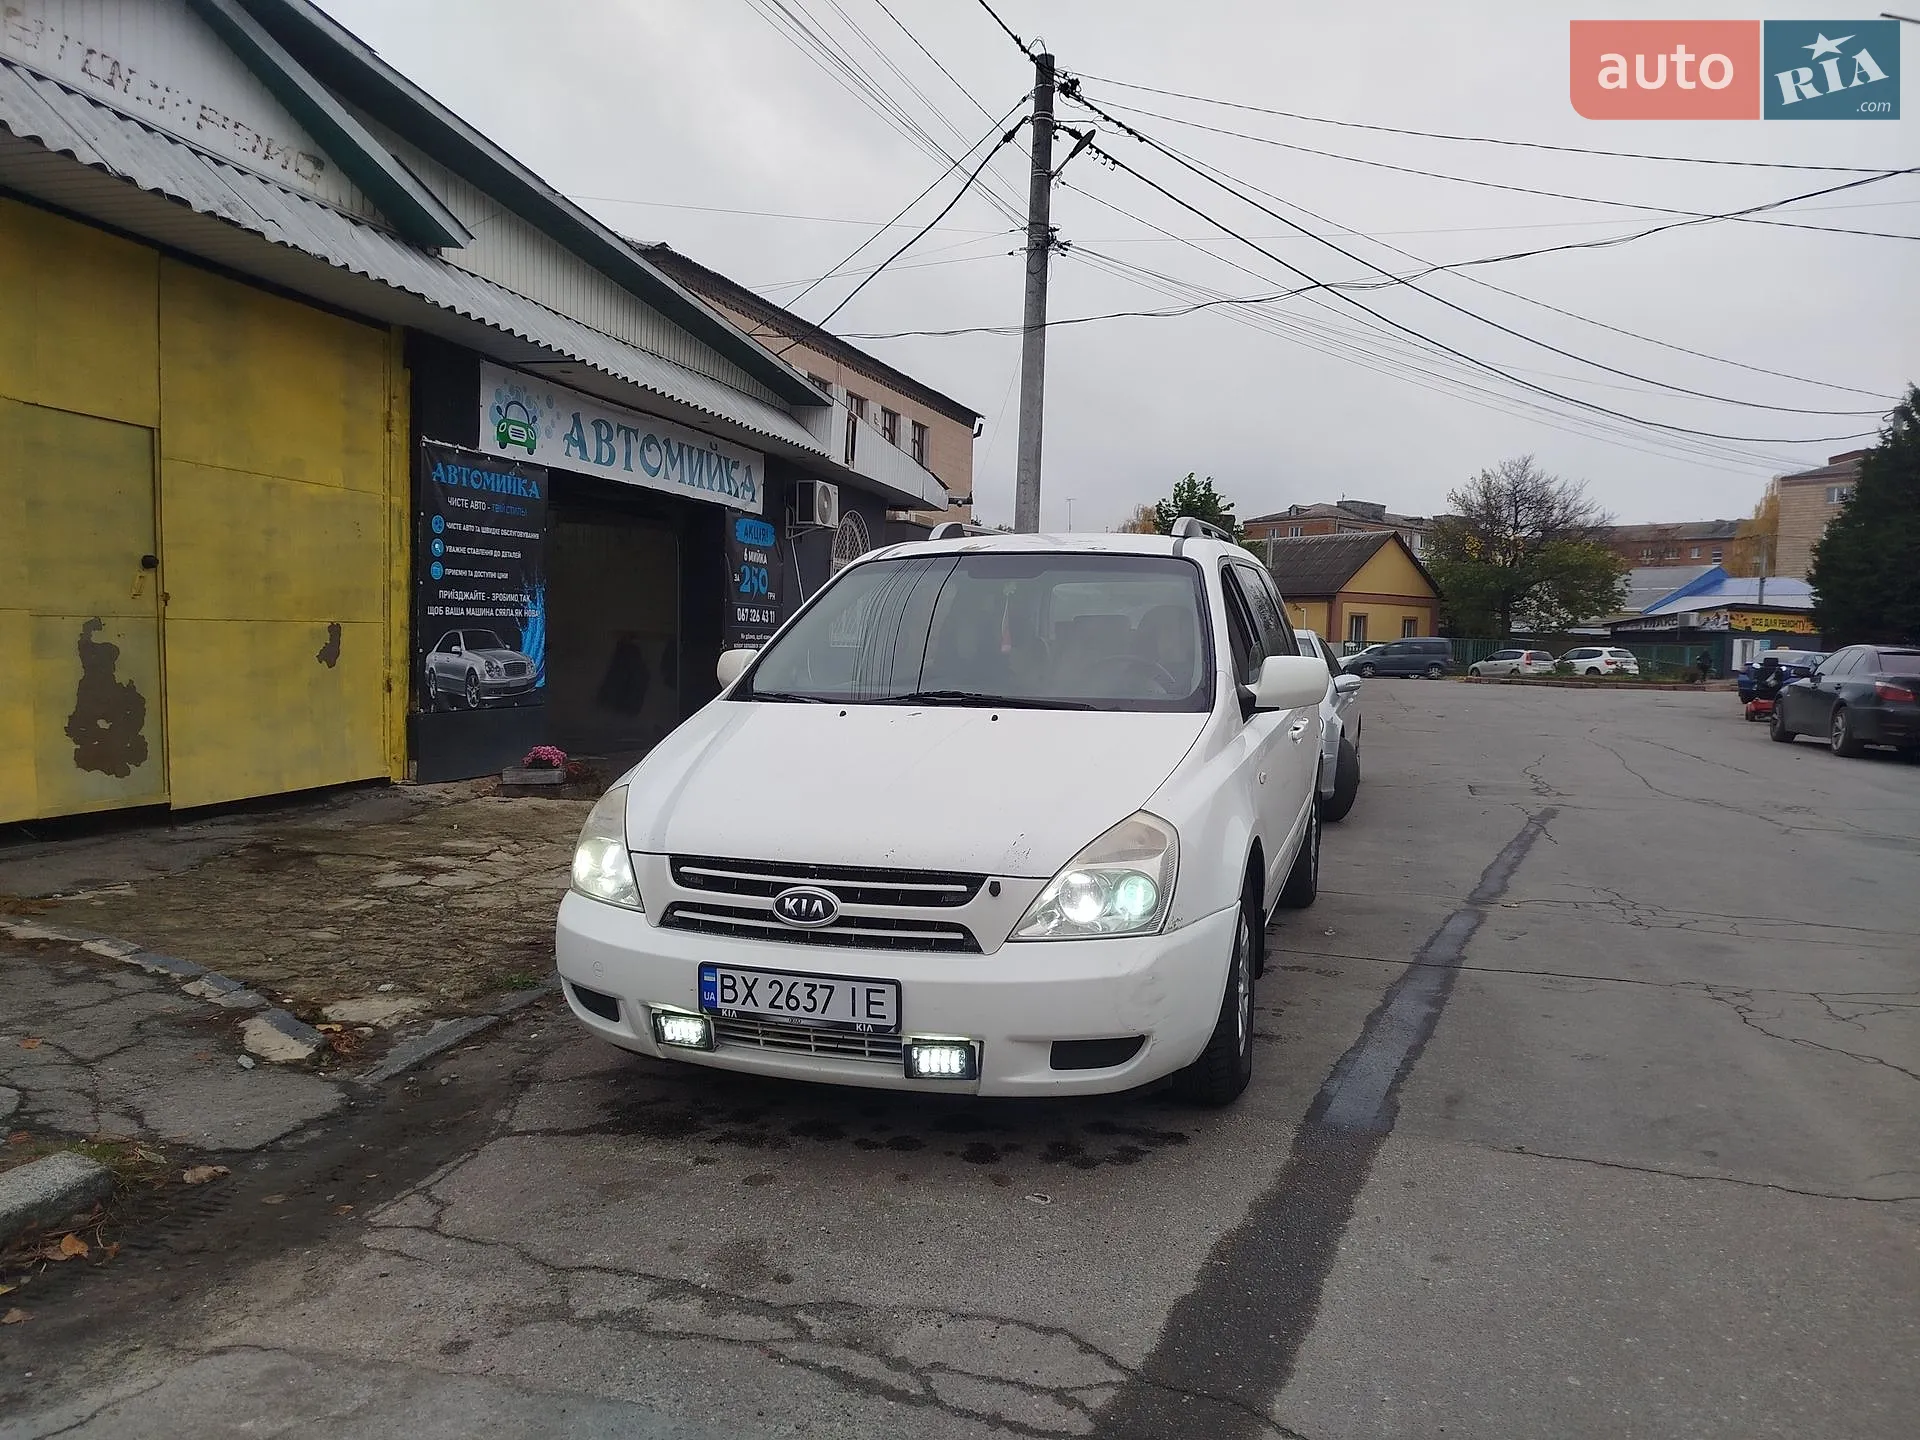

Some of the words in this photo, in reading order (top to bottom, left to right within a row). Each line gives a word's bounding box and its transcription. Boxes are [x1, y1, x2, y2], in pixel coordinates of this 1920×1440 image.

[562, 412, 757, 503] АВТОМИЙКА
[432, 462, 541, 499] АВТОМИЙКА
[447, 496, 469, 509] ЧИСТЕ
[470, 499, 487, 511] АВТО
[446, 522, 462, 531] ЧИСТЕ
[463, 524, 475, 532] АВТО
[743, 523, 769, 543] АКЦІЯ!
[445, 545, 466, 554] УВАЖНЕ
[494, 549, 501, 557] ДО
[501, 550, 522, 559] ДЕТАЛЕЙ
[748, 549, 768, 565] МИЙКА
[734, 573, 740, 582] ЗА
[740, 565, 768, 598] 250
[767, 591, 776, 601] ГРН
[438, 589, 486, 601] ПРИЇЗДЖАЙТЕ
[427, 606, 444, 616] ЩОБ
[445, 606, 465, 616] ВАША
[466, 607, 494, 617] МАШИНА
[737, 608, 748, 622] 067
[749, 609, 760, 623] 326
[762, 610, 769, 623] 43
[770, 610, 775, 623] 11
[1751, 617, 1763, 627] ВСЕ
[1764, 617, 1777, 628] ДЛЯ
[784, 897, 825, 917] KIA
[704, 992, 716, 1001] UA
[720, 974, 760, 1008] BX
[768, 979, 835, 1015] 2637
[851, 986, 887, 1020] IE
[721, 1008, 738, 1018] KIA
[856, 1023, 874, 1033] KIA
